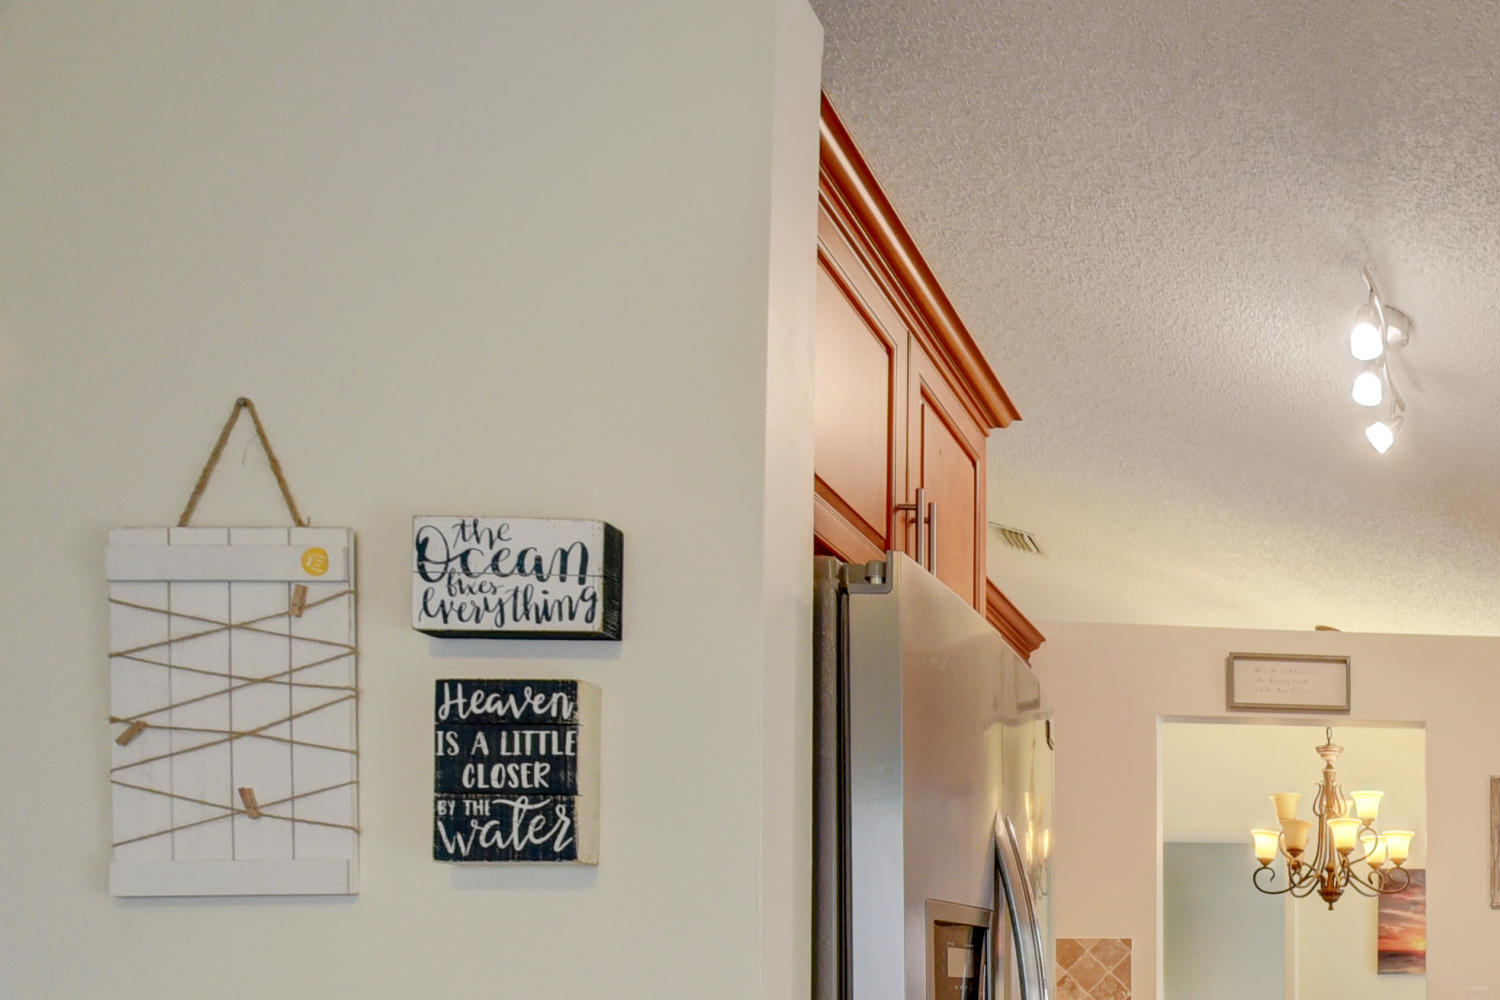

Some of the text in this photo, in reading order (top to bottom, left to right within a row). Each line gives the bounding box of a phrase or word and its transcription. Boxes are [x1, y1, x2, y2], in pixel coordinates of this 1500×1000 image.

[452, 519, 512, 549] the
[416, 525, 589, 585] Ocean
[445, 568, 503, 596] fixes
[438, 682, 574, 720] Heaven
[436, 730, 577, 756] IS A LITTLE
[462, 761, 551, 789] CLOSER
[437, 799, 491, 816] BY THE
